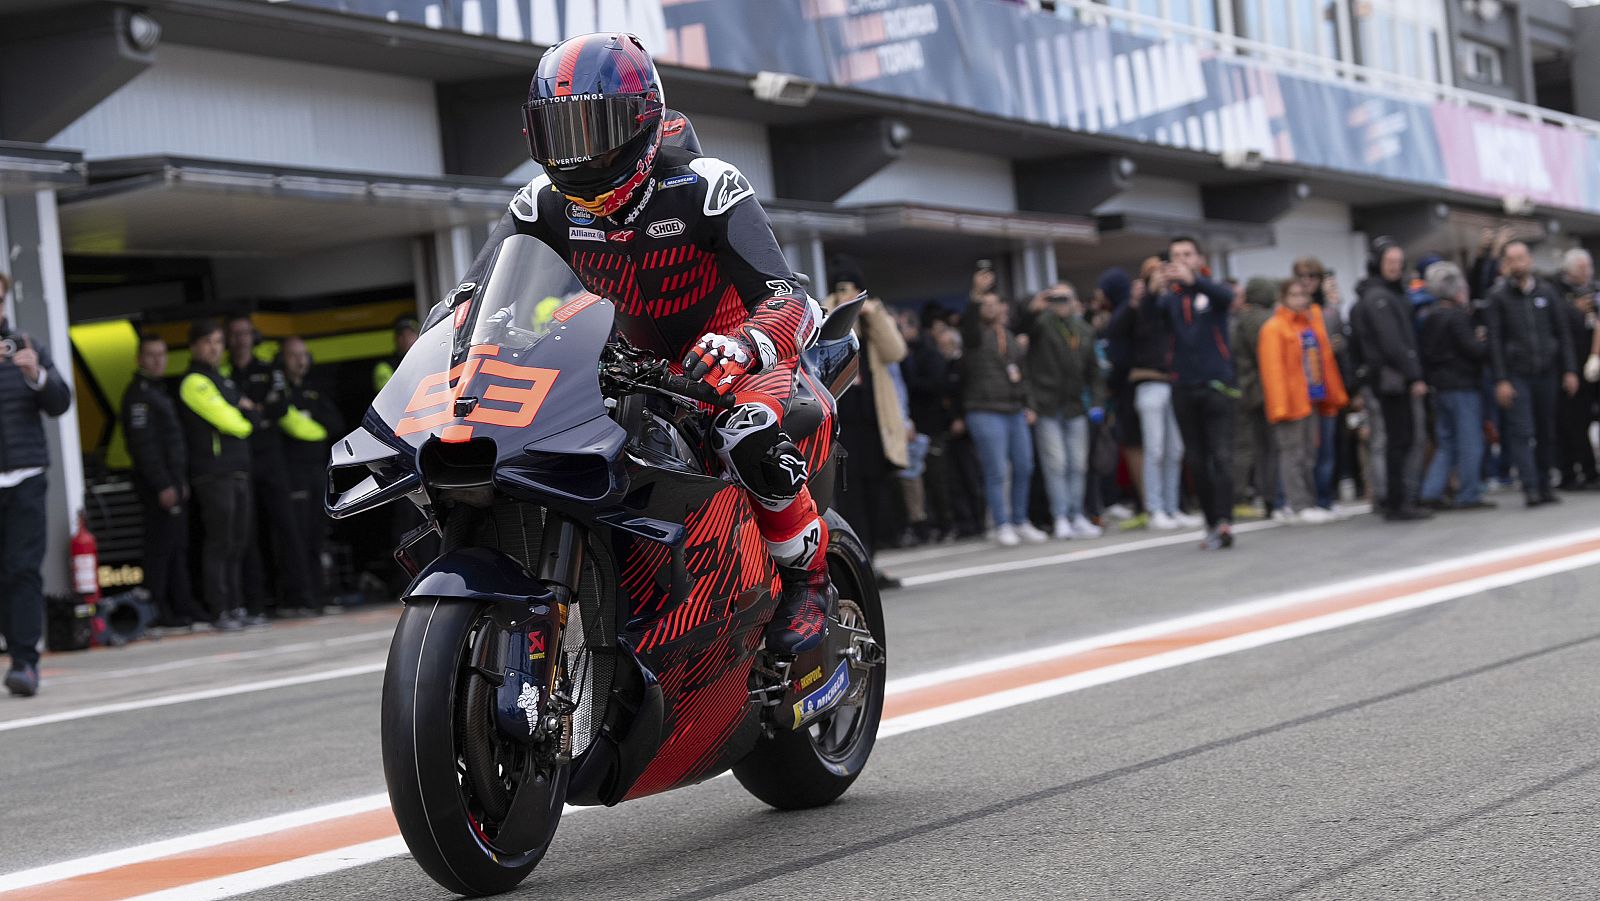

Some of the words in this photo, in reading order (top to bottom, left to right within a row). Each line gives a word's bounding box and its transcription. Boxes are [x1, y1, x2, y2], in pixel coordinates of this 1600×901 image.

[570, 93, 604, 102] WINGS
[555, 155, 592, 165] VERTICAL
[570, 229, 596, 238] Allianz
[652, 222, 680, 234] SHOEI
[395, 356, 561, 438] 93
[816, 671, 845, 710] MICHELIN
